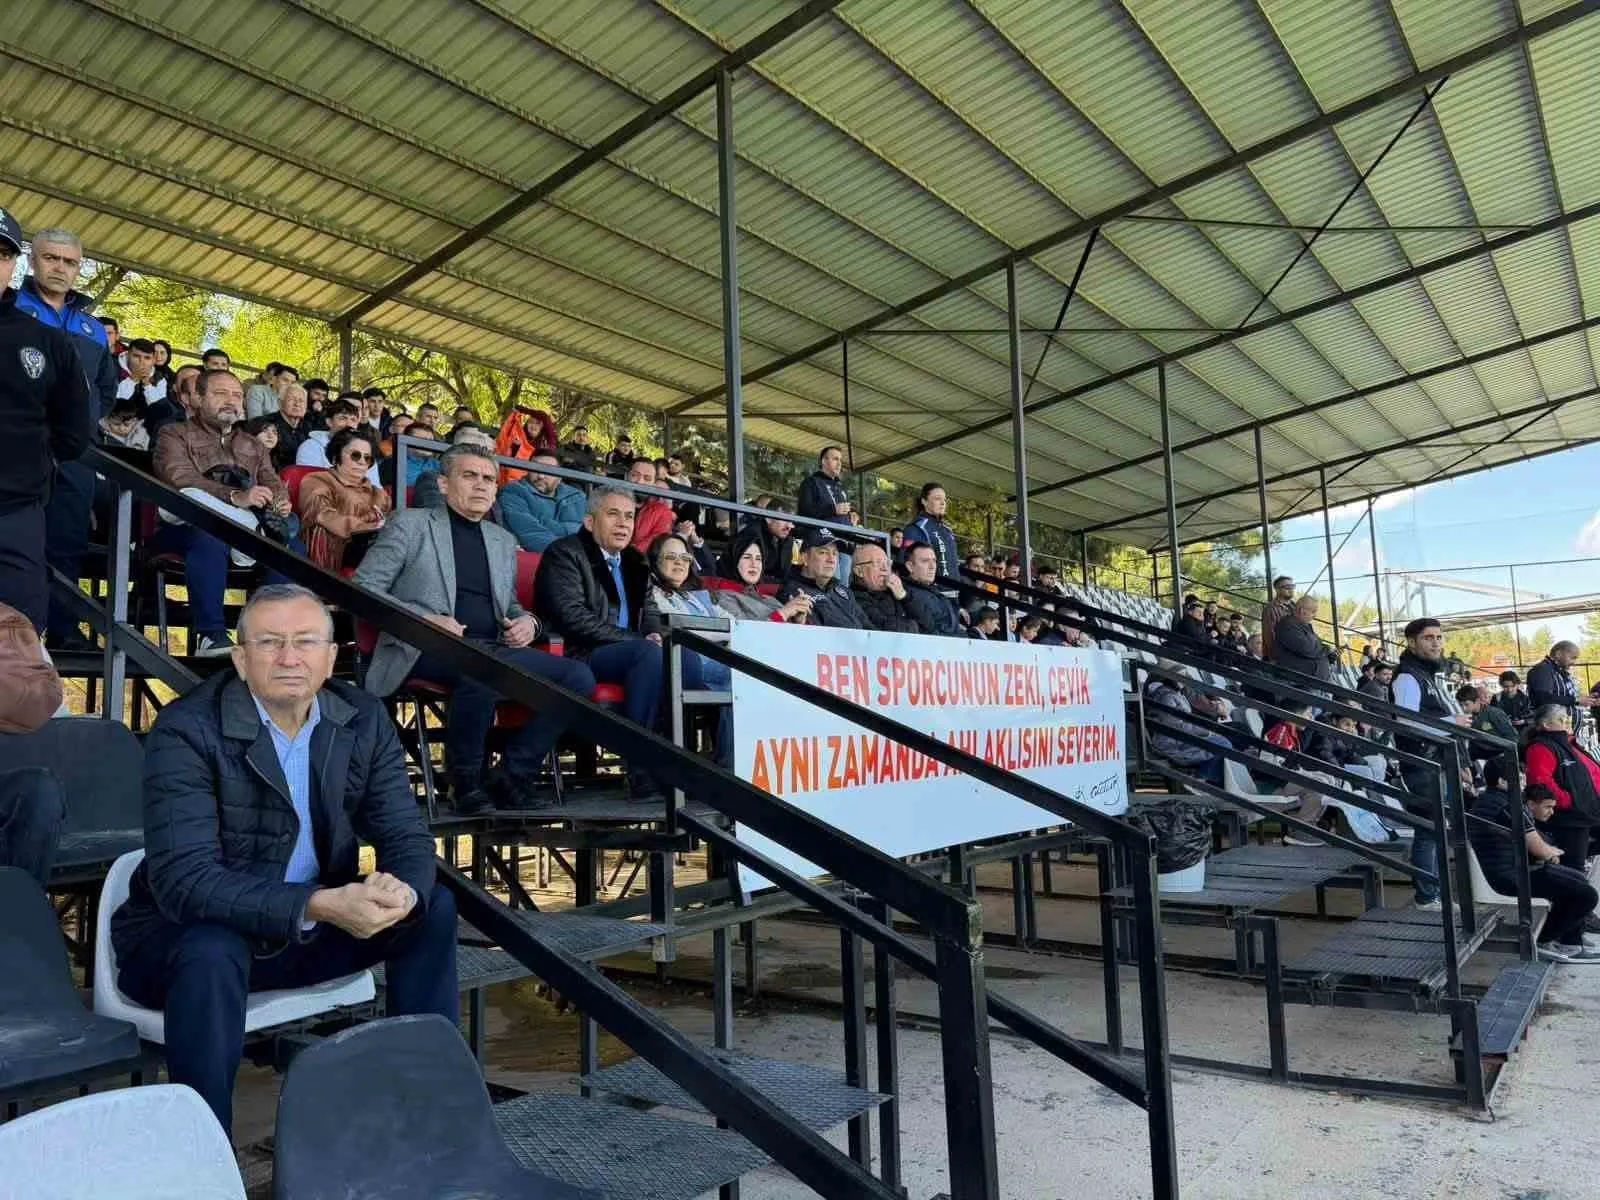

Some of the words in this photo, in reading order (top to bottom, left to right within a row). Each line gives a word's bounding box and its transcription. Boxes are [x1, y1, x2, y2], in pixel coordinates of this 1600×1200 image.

[817, 653, 870, 706] BEN
[876, 656, 999, 706] SPORCUNUN
[1003, 654, 1045, 713] ZEKİ,
[1048, 656, 1090, 713] ÇEVİK
[751, 736, 820, 795] AYNI
[827, 731, 939, 790] ZAMANDA
[1056, 714, 1120, 766] SEVERİM.
